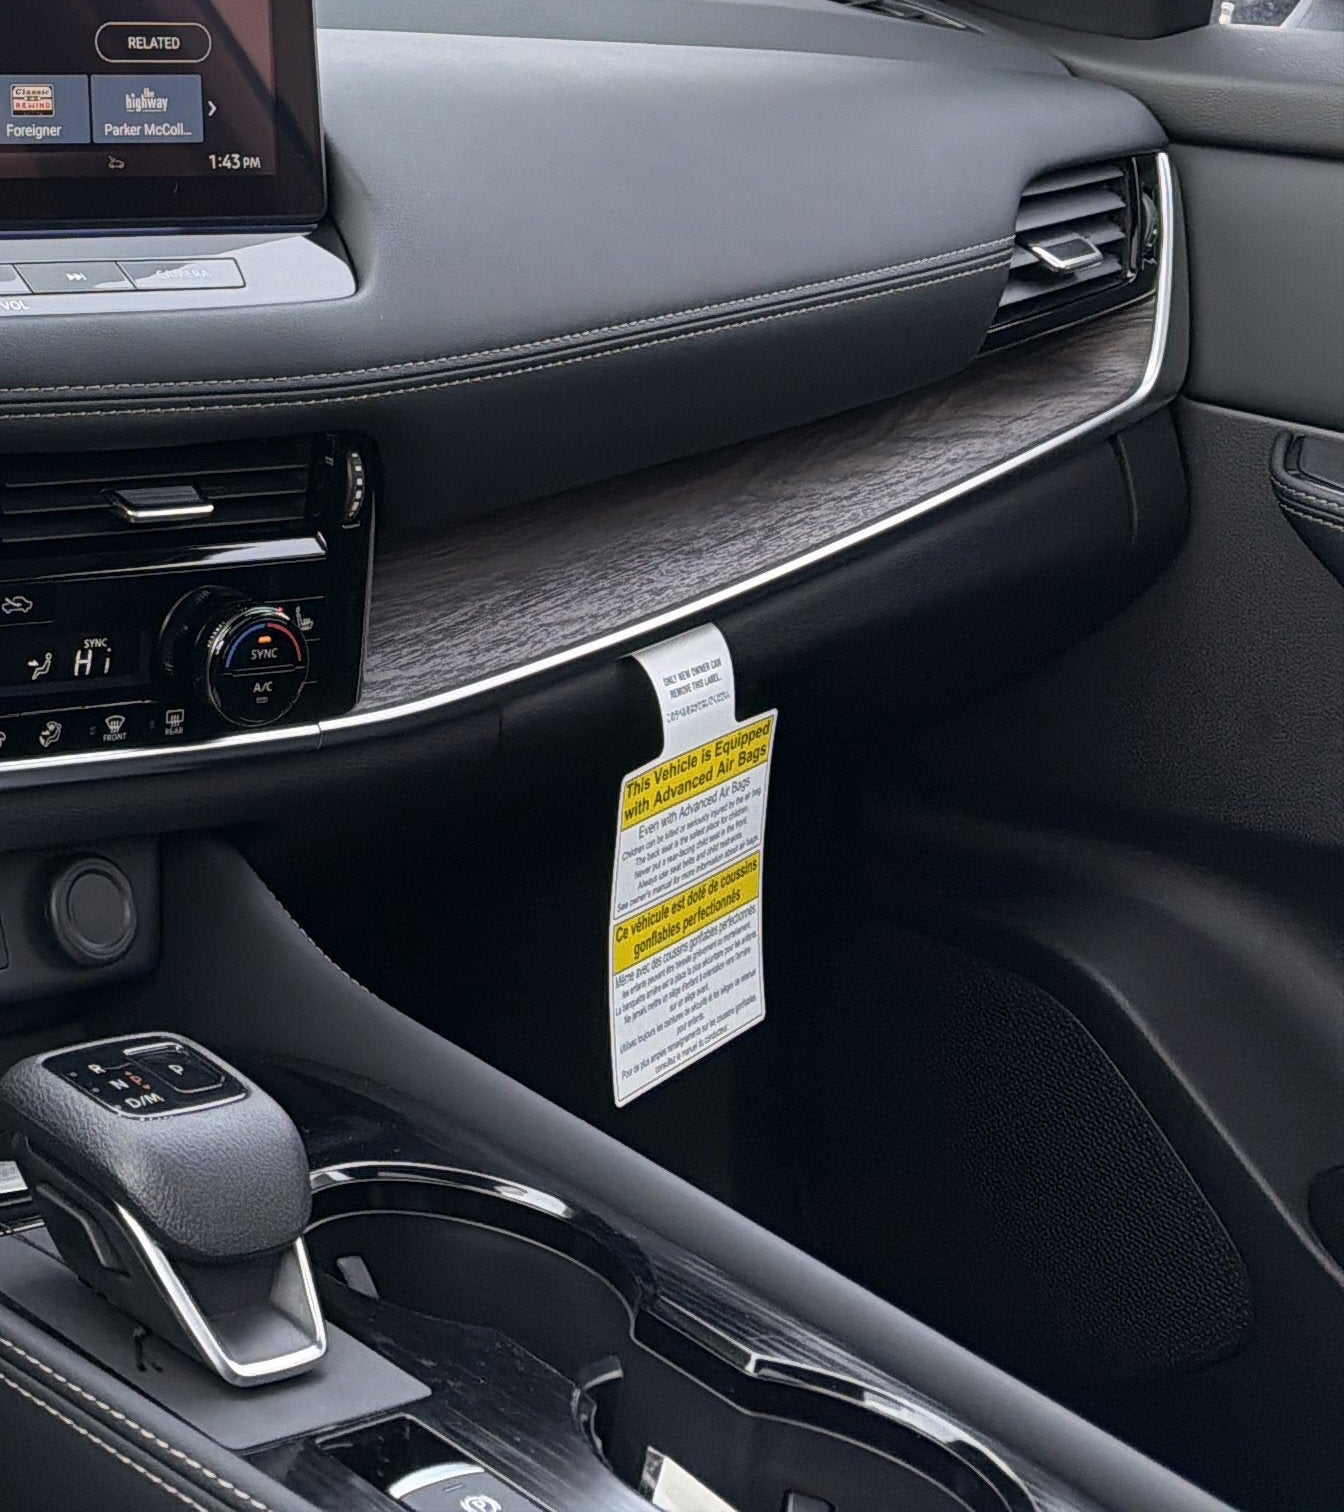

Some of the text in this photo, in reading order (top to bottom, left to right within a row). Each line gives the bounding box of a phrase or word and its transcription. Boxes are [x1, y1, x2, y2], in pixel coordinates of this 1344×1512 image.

[127, 36, 181, 50] RELATED
[15, 88, 49, 96] Classic
[15, 101, 50, 109] REWIND
[126, 92, 169, 112] highway
[6, 124, 62, 139] Foreigner
[104, 123, 141, 136] Parker
[208, 154, 261, 170] 1:43 PM
[0, 299, 31, 311] VOL
[83, 638, 108, 649] SYNC
[250, 647, 279, 661] SYNC
[74, 647, 112, 677] Hi
[253, 681, 273, 693] A/C
[103, 732, 127, 742] FRONT
[164, 726, 184, 736] REAR
[627, 721, 770, 797] This Vehicle is Equipped
[624, 745, 766, 819] with Advanced Air Bags
[638, 778, 750, 838] Even with Advanced Air Bags
[618, 860, 756, 942] Ce véhicule est doté de coussins
[634, 889, 740, 958] gonflables perfectionnés
[87, 1063, 106, 1075] R
[168, 1064, 184, 1076] P
[108, 1078, 130, 1090] N
[124, 1092, 165, 1109] D/M
